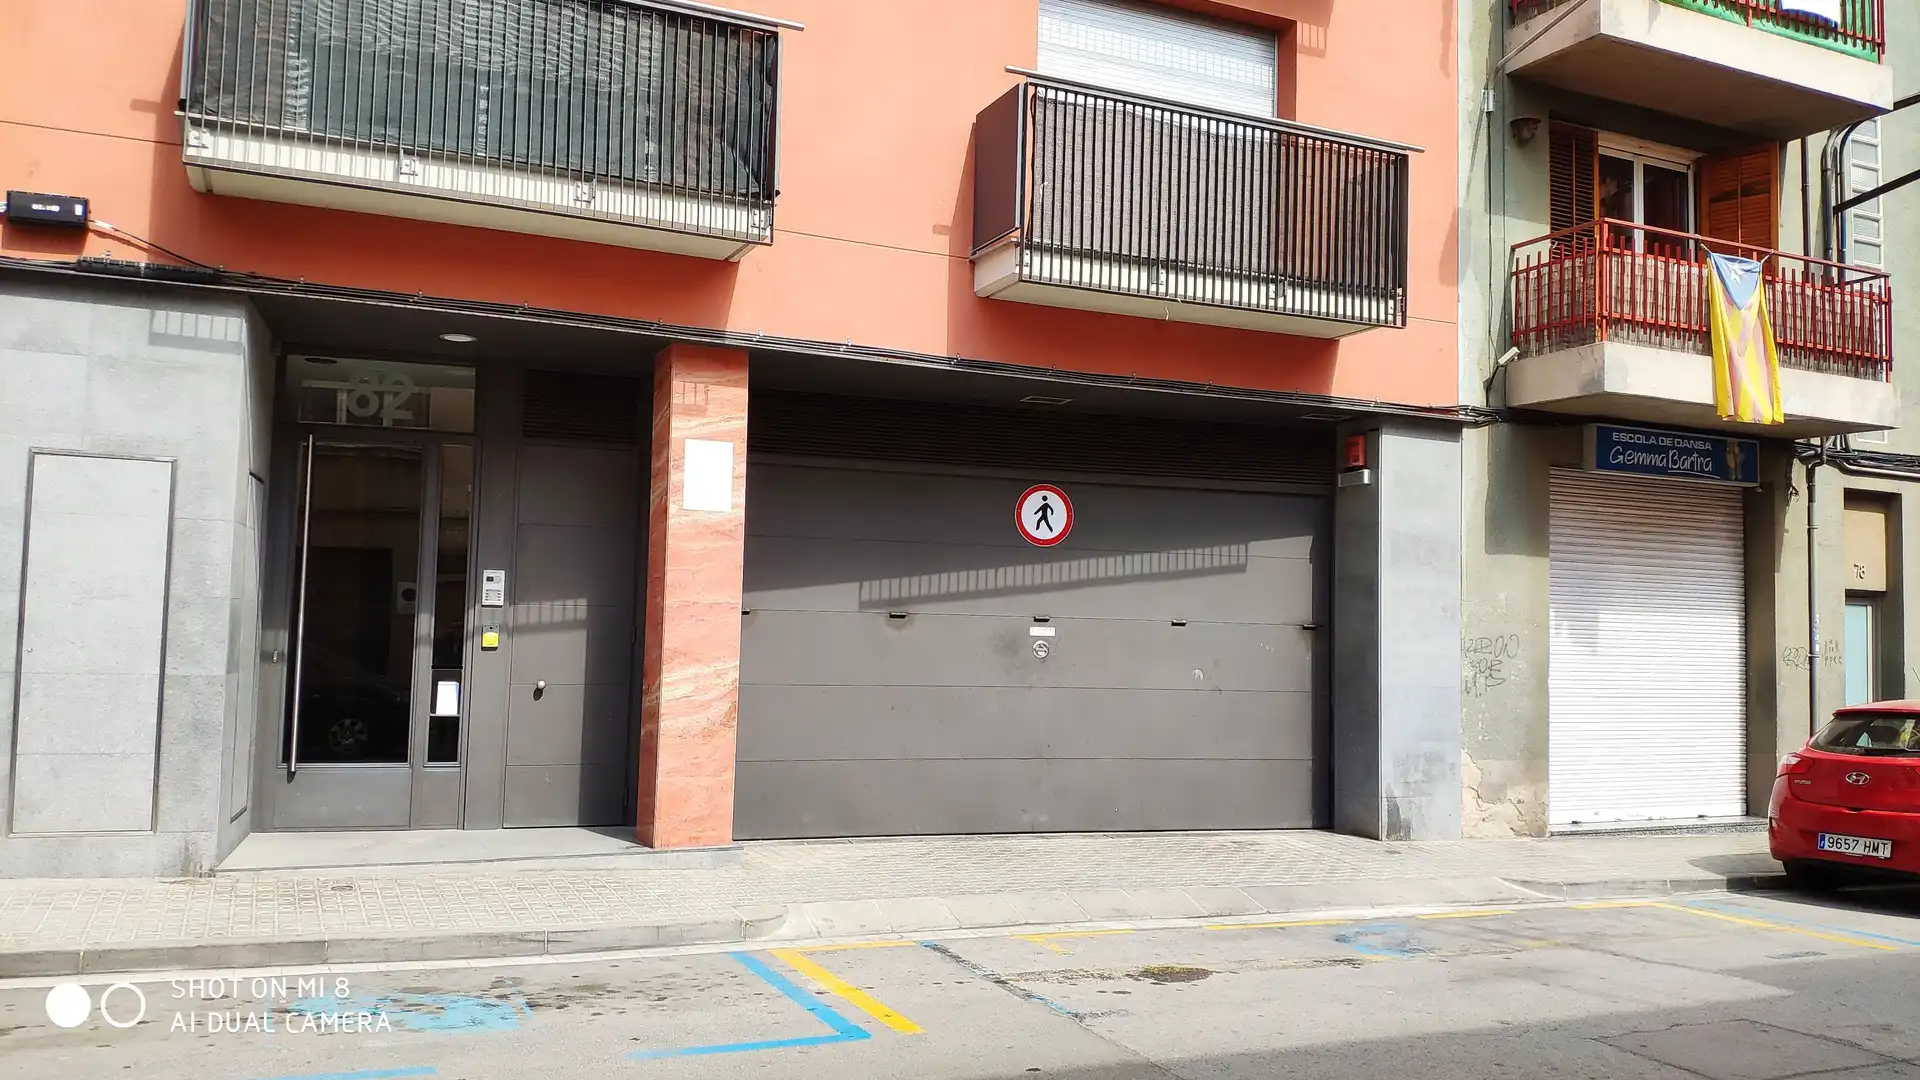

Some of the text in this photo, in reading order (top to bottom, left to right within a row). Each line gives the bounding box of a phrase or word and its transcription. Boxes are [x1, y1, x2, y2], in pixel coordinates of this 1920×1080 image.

[348, 370, 415, 420] 82
[1612, 432, 1713, 451] ESCOLA DE DANSA
[1609, 445, 1713, 472] Gemma Bartra
[1827, 836, 1859, 851] 9657
[1863, 840, 1888, 855] HMT
